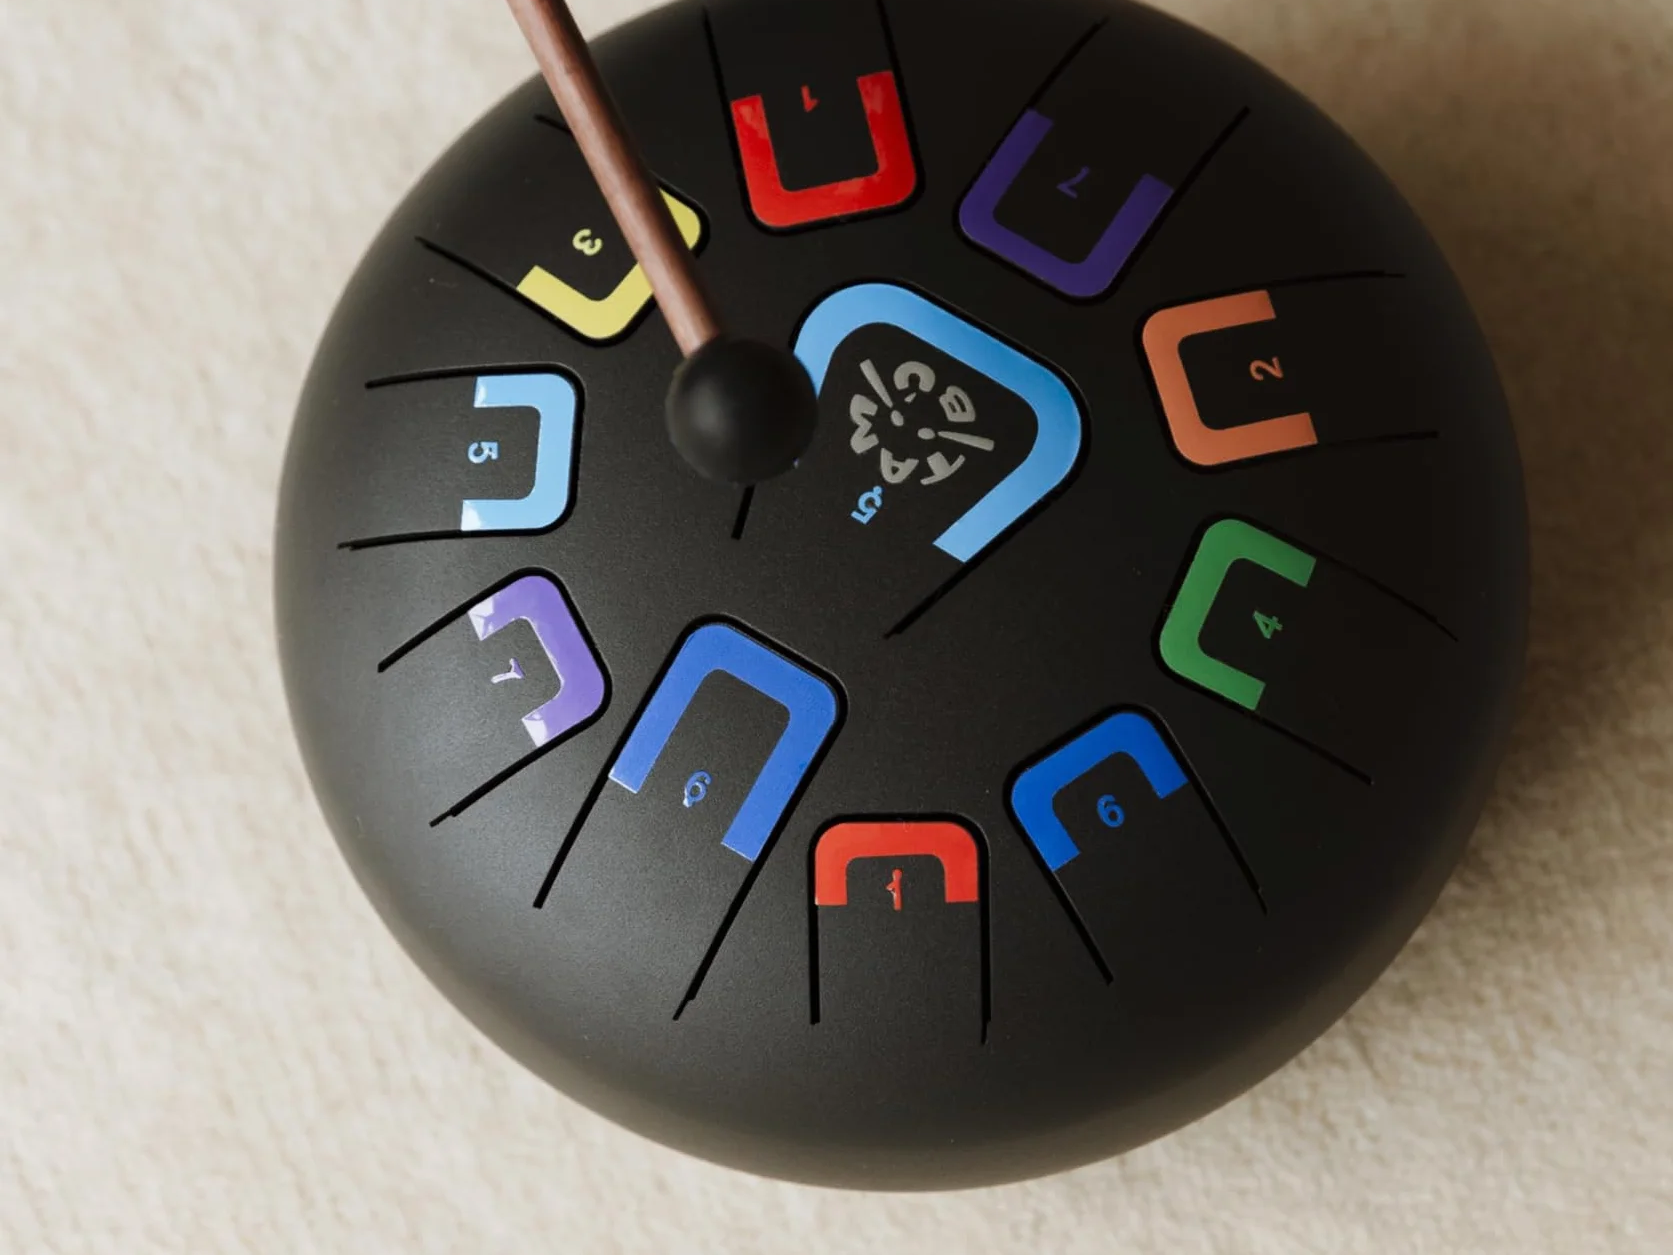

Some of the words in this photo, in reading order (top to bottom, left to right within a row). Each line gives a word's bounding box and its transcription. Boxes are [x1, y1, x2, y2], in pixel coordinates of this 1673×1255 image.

[1056, 166, 1090, 199] 7
[573, 228, 603, 257] 3
[1249, 356, 1284, 381] 2
[467, 441, 499, 464] 5
[1252, 610, 1283, 640] 4
[1096, 794, 1125, 828] 6
